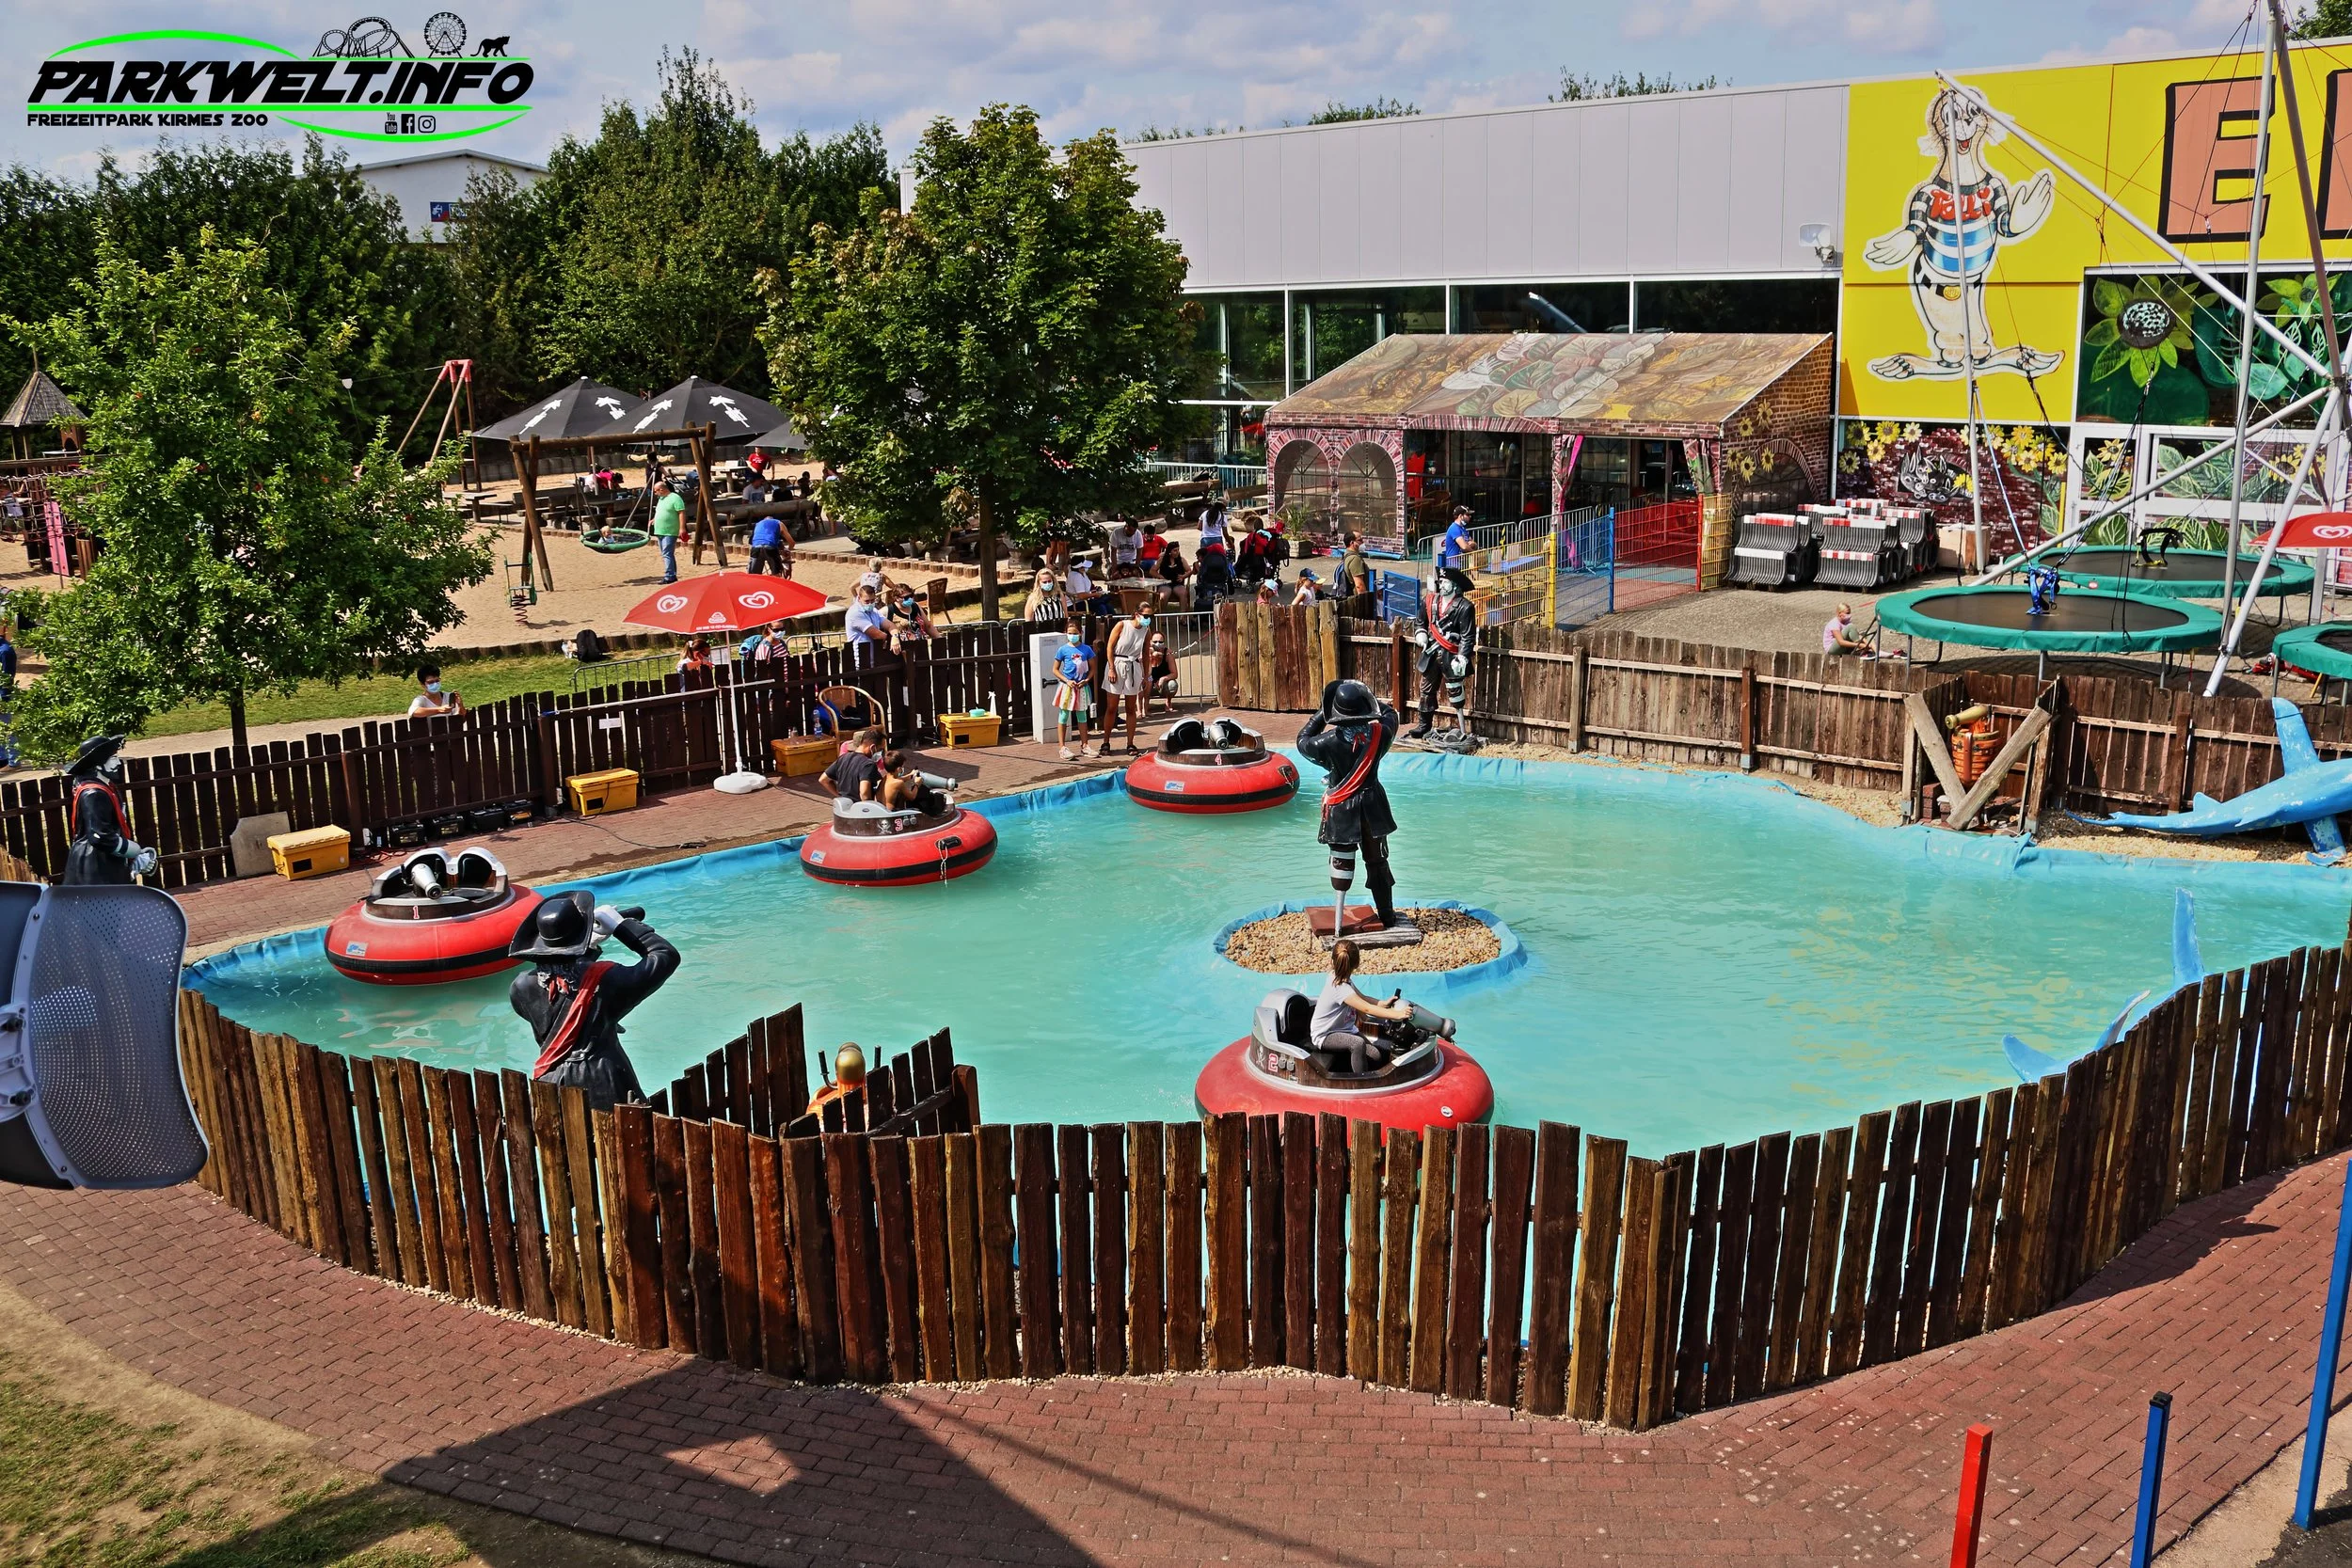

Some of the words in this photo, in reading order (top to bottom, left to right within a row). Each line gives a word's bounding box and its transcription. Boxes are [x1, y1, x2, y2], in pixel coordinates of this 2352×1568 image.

[1215, 753, 1222, 766] 4
[894, 818, 903, 832] 3
[412, 905, 420, 920] 1
[1267, 1053, 1279, 1072] 2
